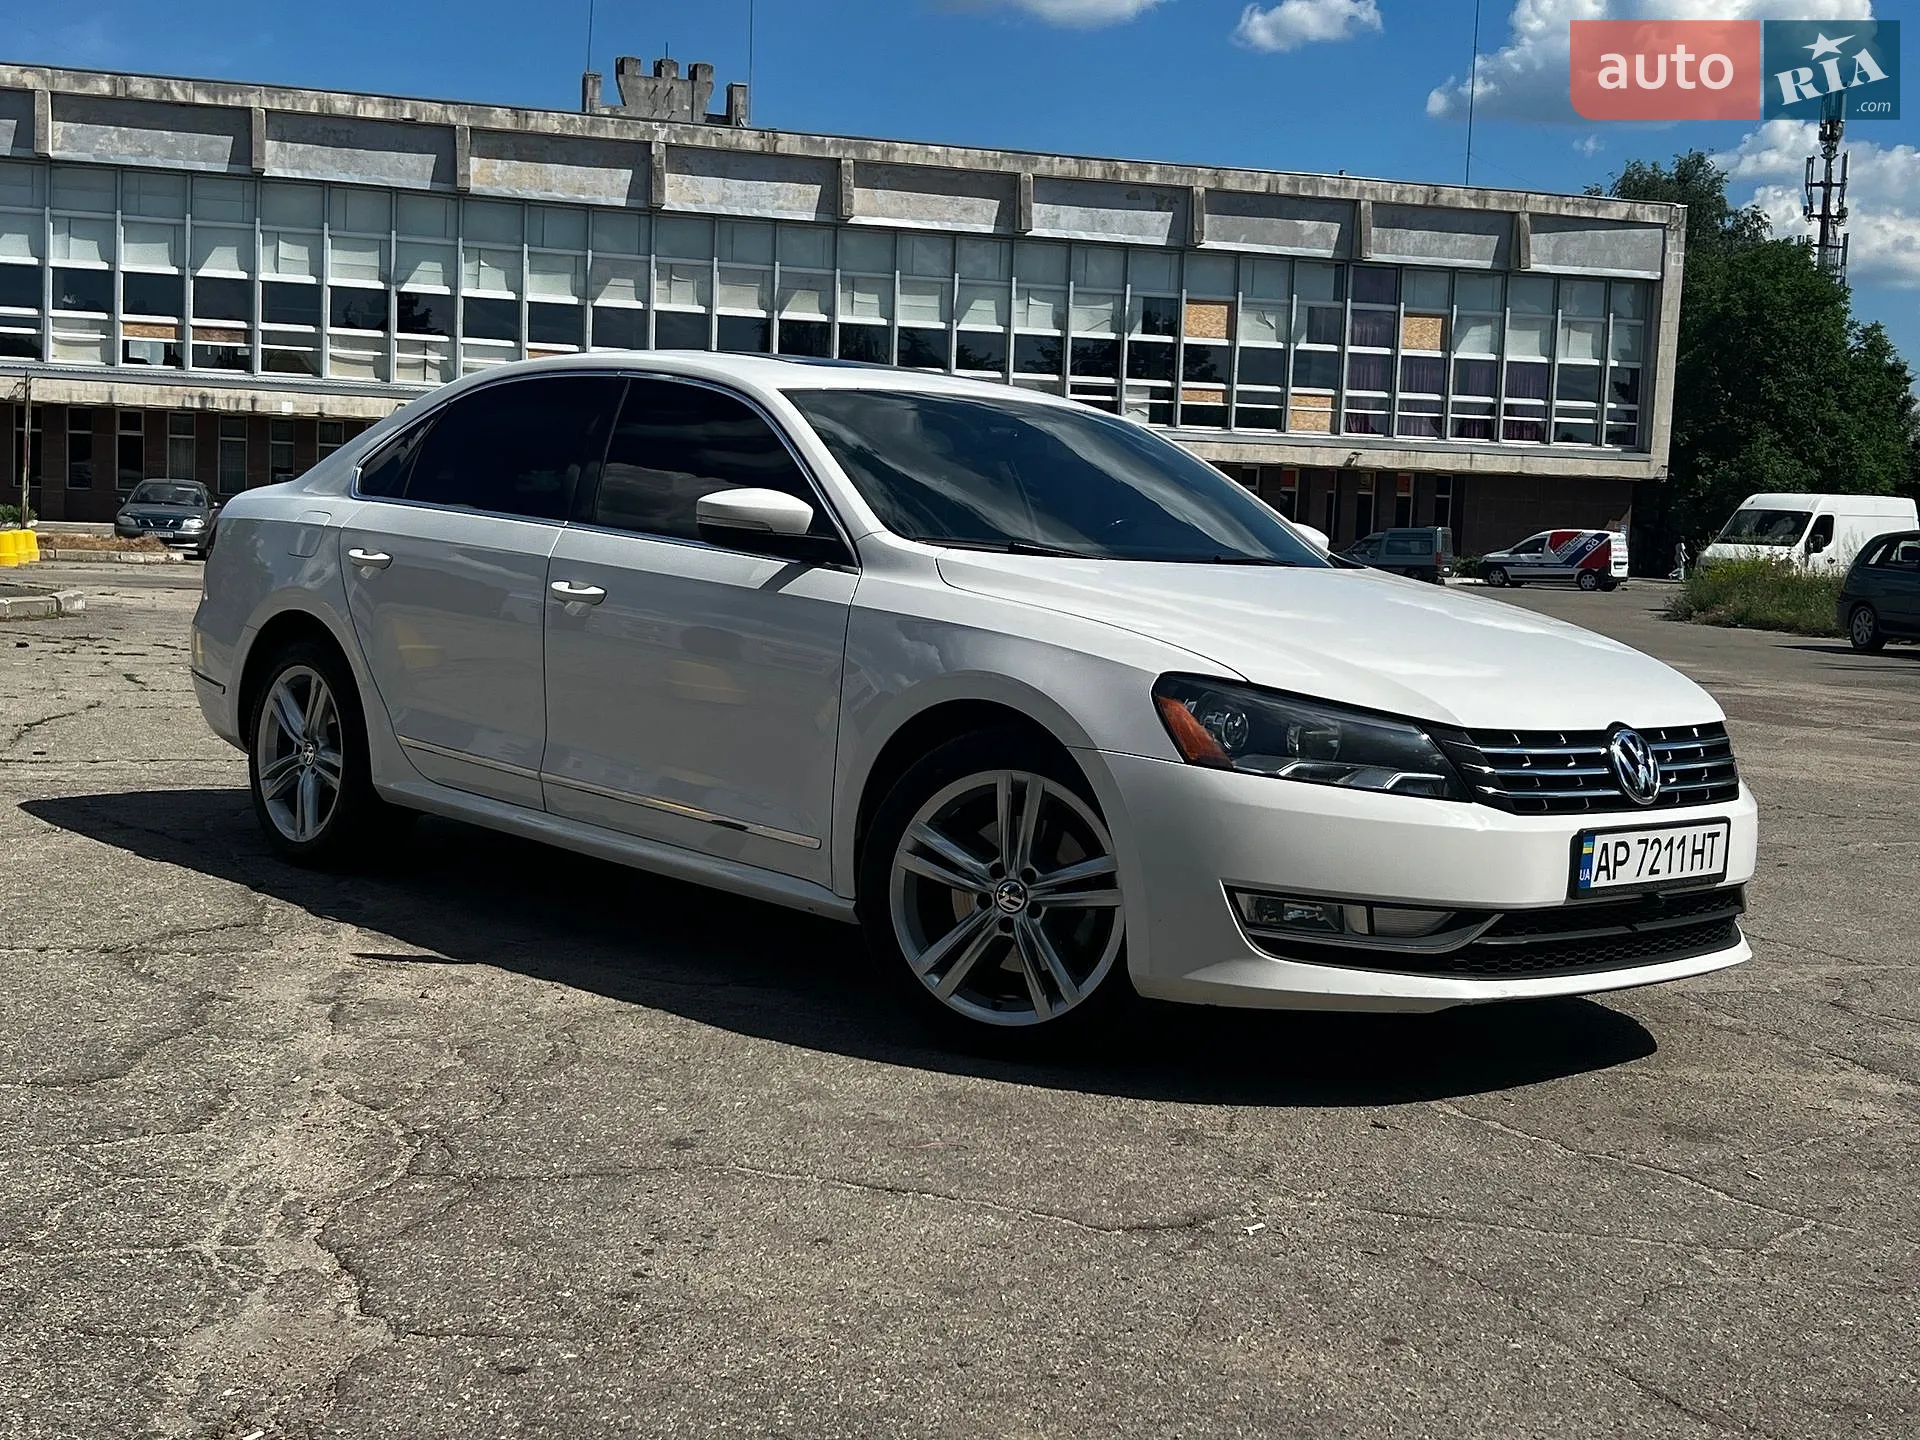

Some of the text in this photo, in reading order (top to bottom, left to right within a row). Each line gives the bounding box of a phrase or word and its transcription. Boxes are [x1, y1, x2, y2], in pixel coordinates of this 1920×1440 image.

[1594, 831, 1720, 882] AP 7211 HT
[1579, 868, 1590, 881] UA
